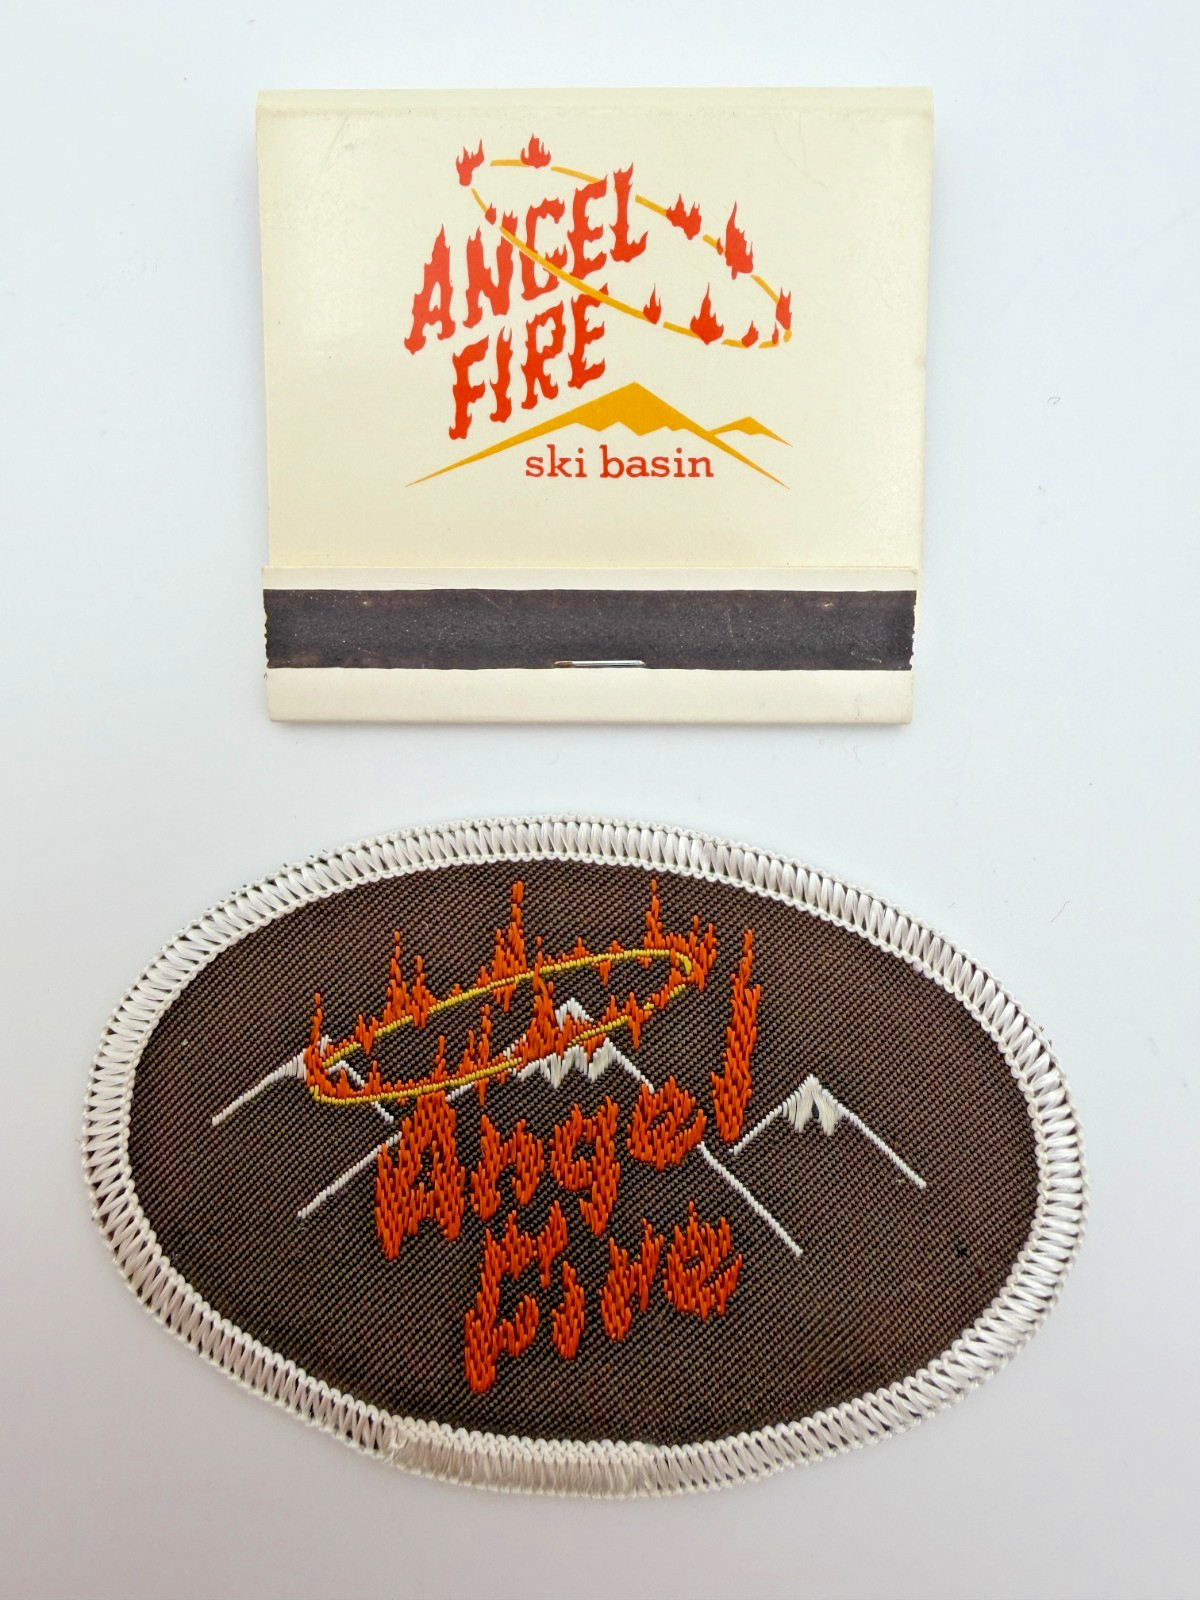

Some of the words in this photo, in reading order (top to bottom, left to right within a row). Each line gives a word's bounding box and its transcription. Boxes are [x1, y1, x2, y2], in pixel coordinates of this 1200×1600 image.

[404, 162, 648, 355] ANGEL
[448, 282, 609, 440] FIRE
[525, 444, 587, 478] ski
[599, 444, 715, 478] basin
[375, 929, 762, 1261] Angel
[464, 1201, 744, 1394] Fire
